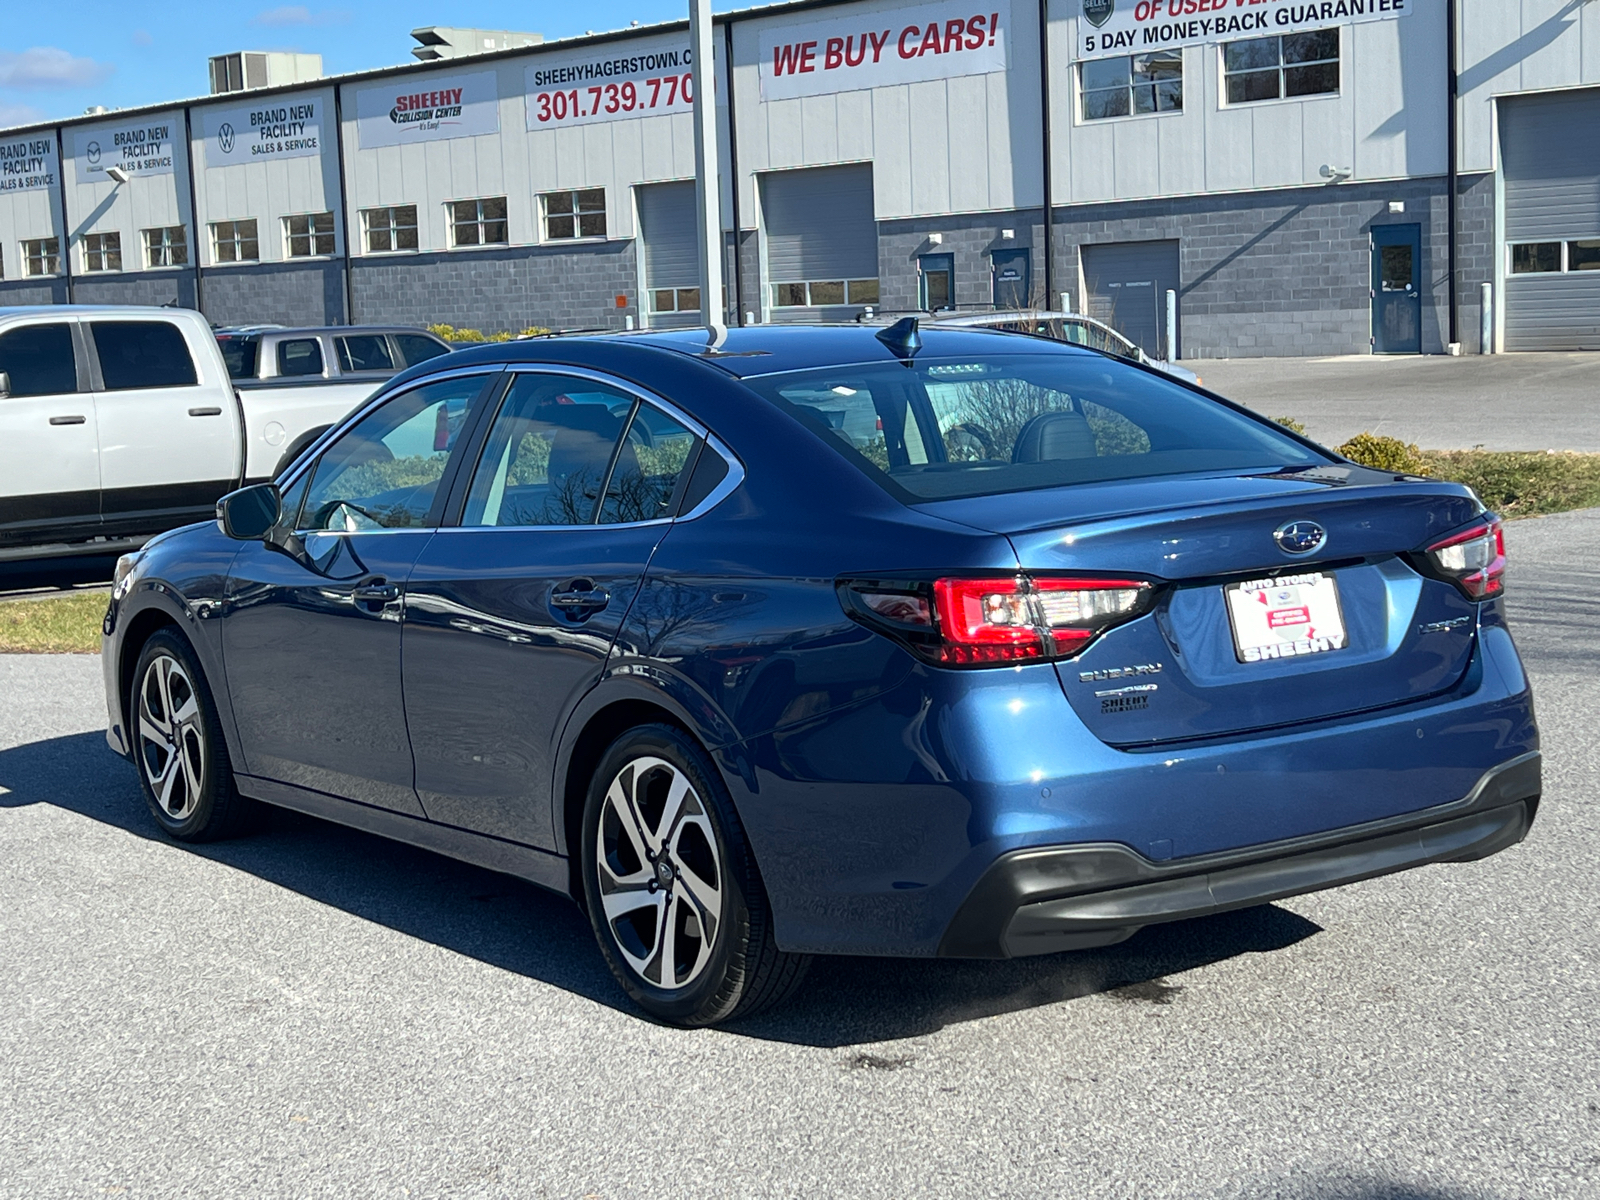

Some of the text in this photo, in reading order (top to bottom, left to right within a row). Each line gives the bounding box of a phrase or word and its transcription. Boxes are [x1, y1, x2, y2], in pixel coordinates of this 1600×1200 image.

[1134, 0, 1161, 21] OF
[1085, 0, 1404, 51] 5 DAY MONEY-BACK GUARANTEE
[773, 13, 999, 77] WE BUY CARS!
[535, 47, 715, 86] SHEEHYHAGERSTOWN.C
[396, 88, 463, 112] SHEEHY
[536, 73, 716, 122] 301.739.770
[250, 104, 314, 126] BRAND NEW
[397, 106, 462, 123] COLLISION CENTER
[114, 126, 169, 146] BRAND NEW
[260, 121, 305, 140] FACILITY
[29, 140, 50, 156] NEW
[122, 142, 161, 159] FACILITY
[251, 138, 317, 155] SALES & SERVICE
[3, 157, 43, 176] FACILITY
[137, 160, 143, 170] &
[144, 157, 172, 169] SERVICE
[18, 178, 24, 188] &
[25, 174, 54, 187] SERVICE
[1240, 578, 1274, 591] AUTO
[1243, 634, 1344, 662] SHEEHY
[1079, 662, 1162, 682] SUBARU
[1101, 695, 1149, 709] SHEEHY
